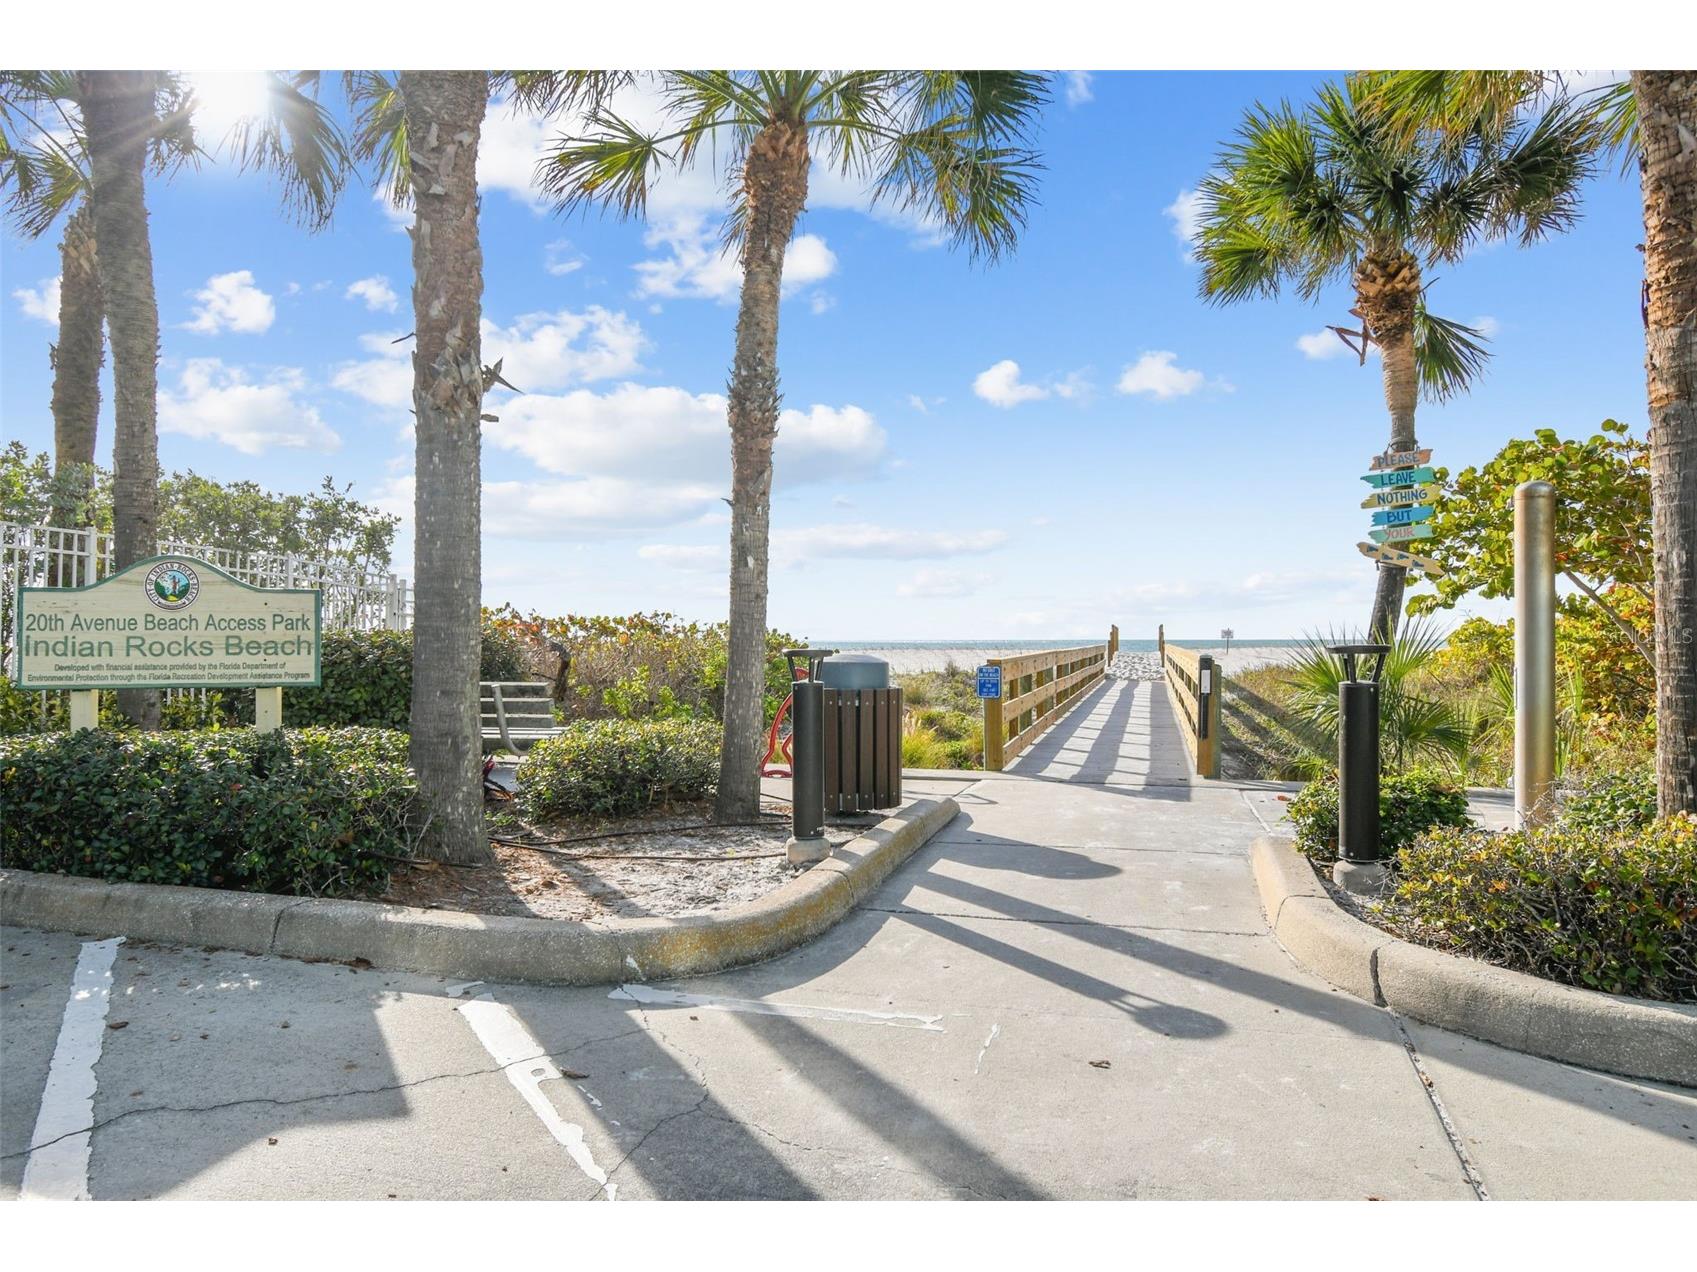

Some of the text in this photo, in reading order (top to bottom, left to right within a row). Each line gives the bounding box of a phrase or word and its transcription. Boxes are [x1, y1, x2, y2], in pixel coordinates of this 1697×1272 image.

[1377, 452, 1418, 467] PLEASE
[1381, 471, 1416, 486] LEAVE
[1376, 489, 1428, 505] NOTHING
[1386, 509, 1412, 523] BUT
[1385, 527, 1415, 539] YOUR
[25, 613, 311, 631] 20th Avenue Beach Access Park
[25, 635, 312, 657] Indian Rocks Beach
[54, 663, 90, 672] Developed
[105, 663, 133, 671] financial
[134, 663, 168, 671] assistance
[169, 662, 197, 671] provided
[198, 662, 206, 671] by
[207, 662, 217, 670] the
[218, 662, 240, 670] Florida
[242, 662, 278, 671] Department
[279, 661, 287, 669] of
[76, 673, 109, 681] Protection
[110, 673, 135, 682] through
[148, 672, 171, 680] Florida
[172, 672, 206, 680] Recreation
[207, 672, 248, 680] Development
[249, 671, 282, 680] Assistance
[284, 671, 311, 680] Program
